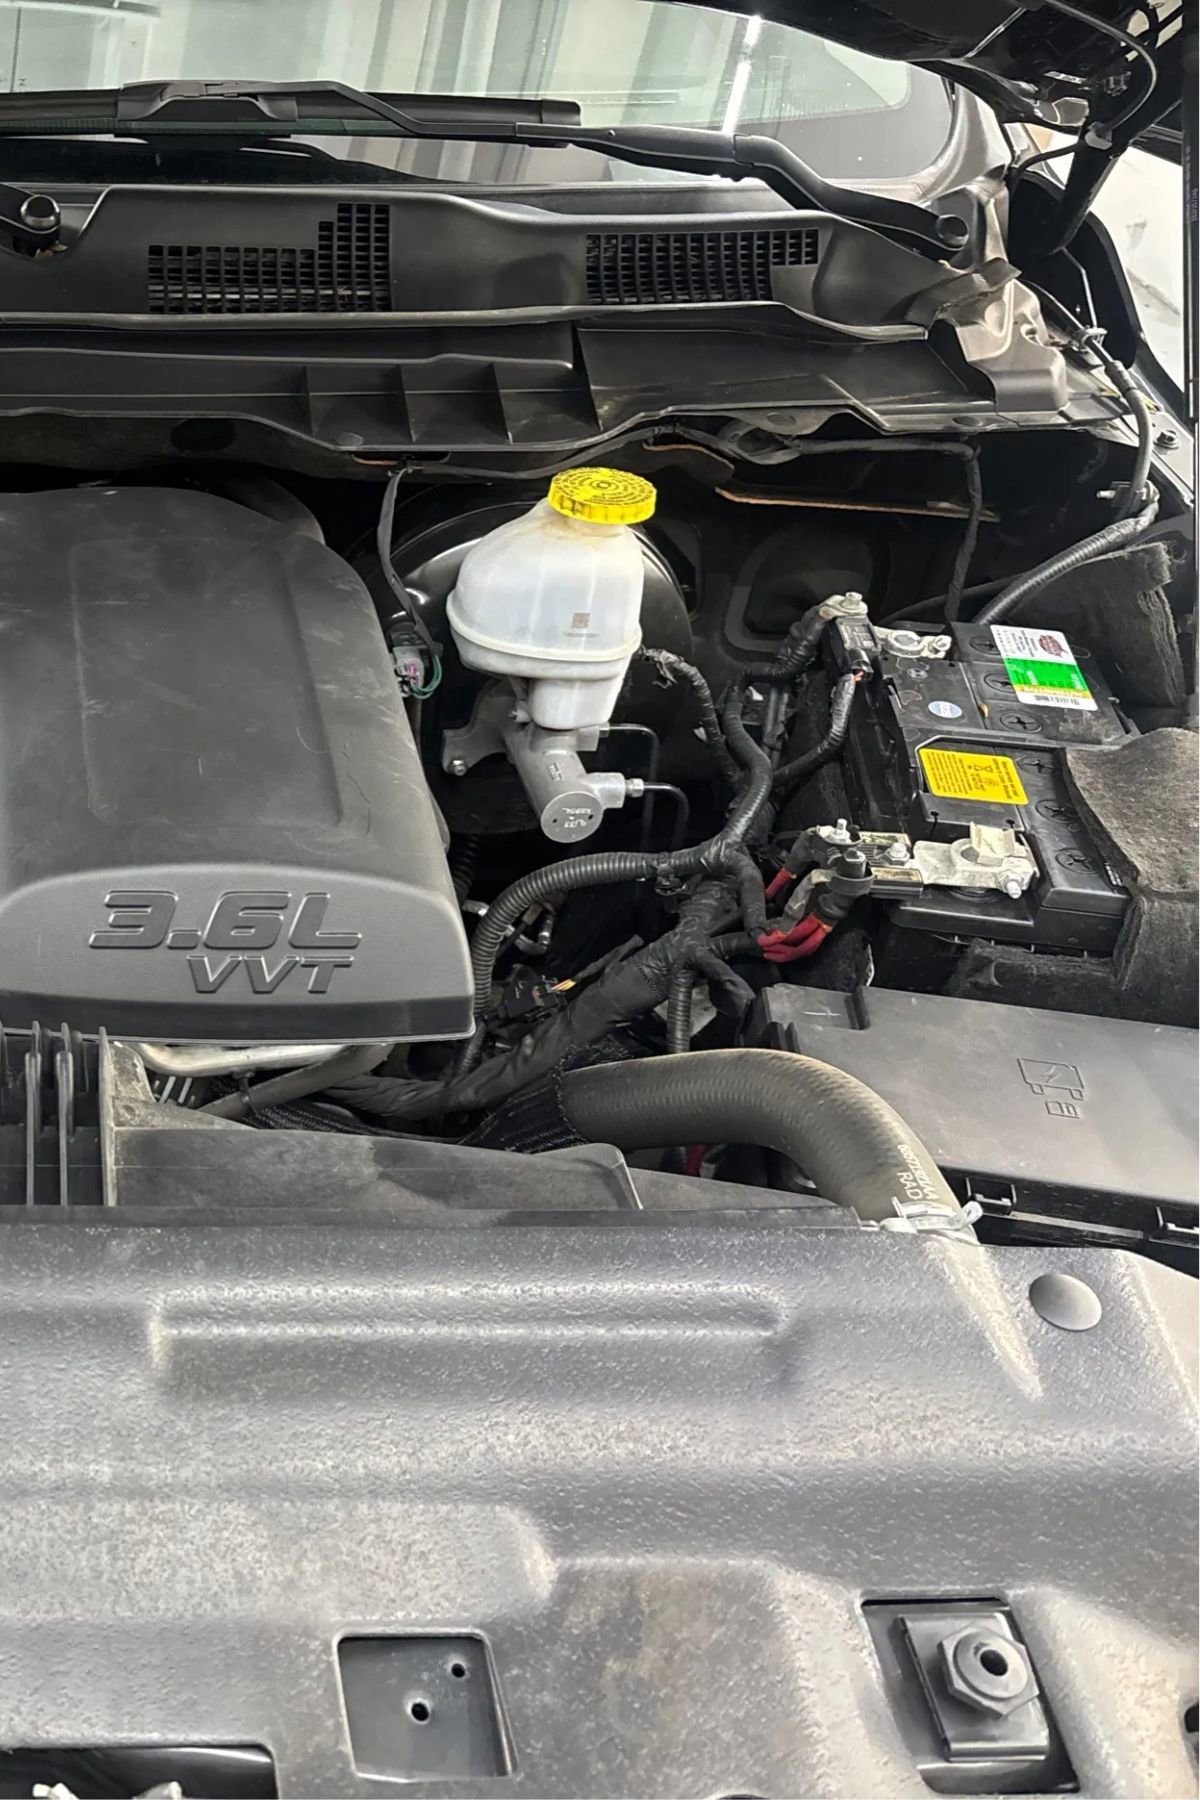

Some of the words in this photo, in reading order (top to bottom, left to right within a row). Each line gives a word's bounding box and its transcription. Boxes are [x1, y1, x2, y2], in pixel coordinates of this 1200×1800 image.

[88, 890, 363, 950] 3.6L
[186, 954, 354, 994] VVT
[896, 1171, 923, 1200] RAD
